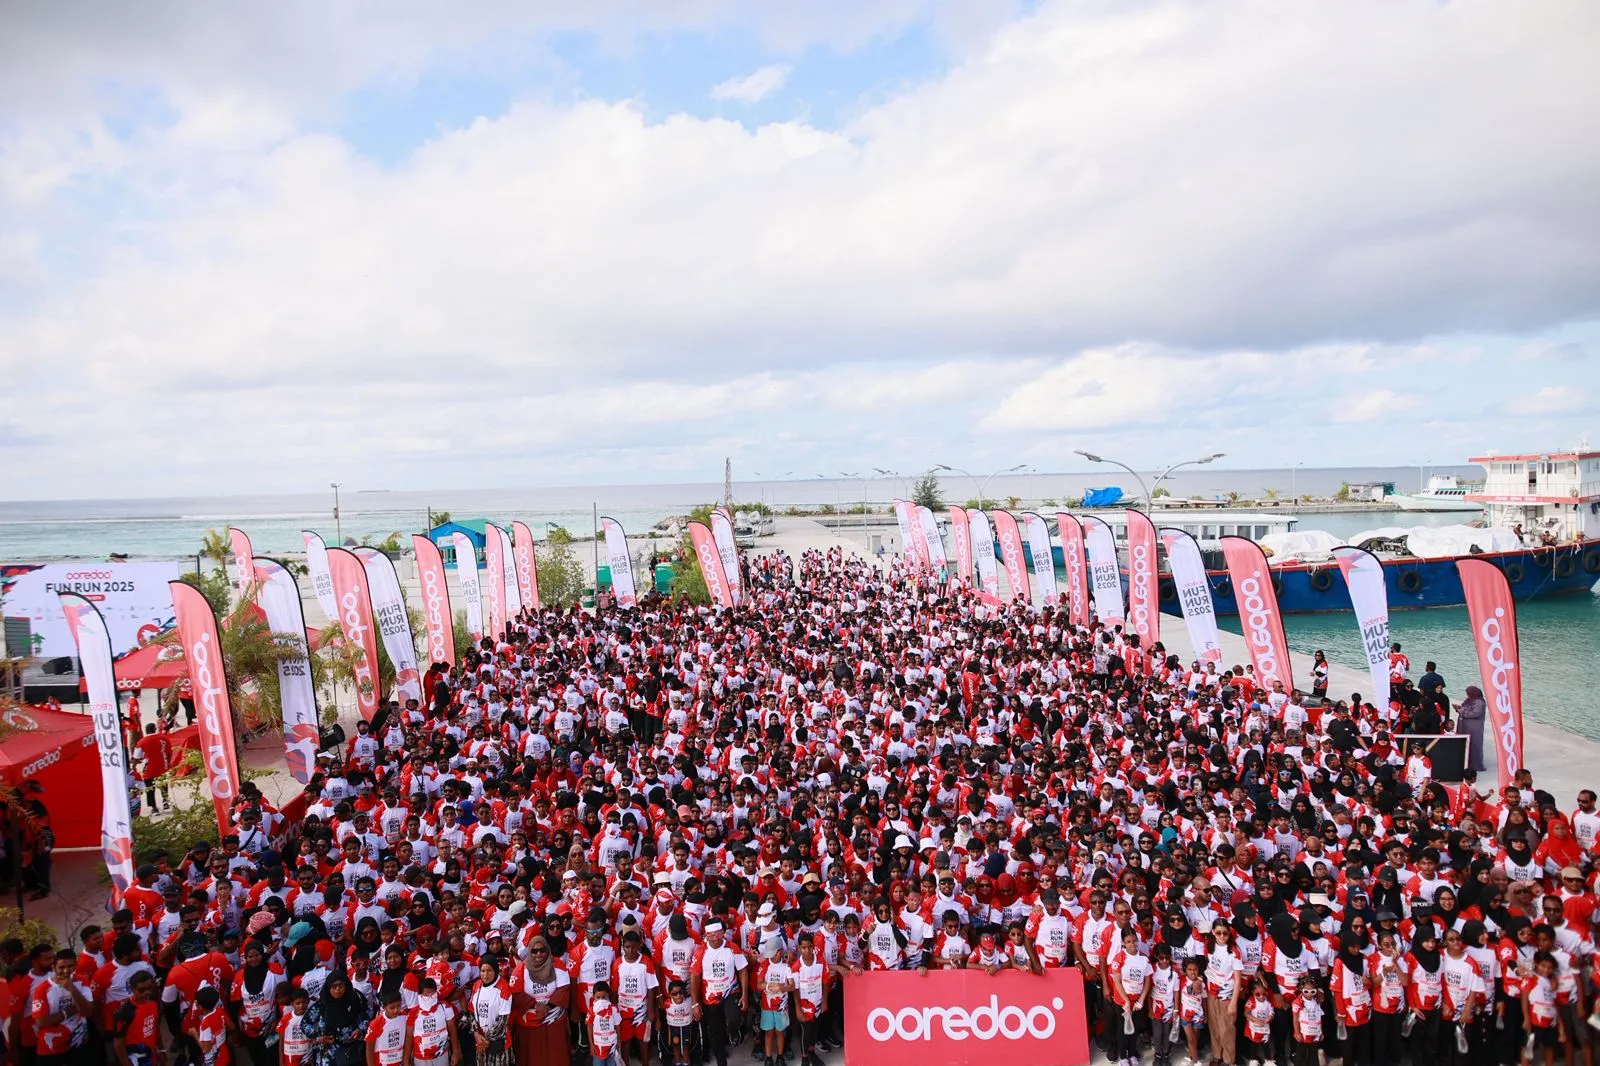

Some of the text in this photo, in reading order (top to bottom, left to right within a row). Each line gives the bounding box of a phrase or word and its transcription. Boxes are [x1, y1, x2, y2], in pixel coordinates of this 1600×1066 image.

[46, 581, 135, 593] FUN RUN 2025
[66, 569, 112, 580] ooredoo
[424, 566, 446, 660] ooredoo
[1134, 541, 1152, 635] ooredoo
[1241, 570, 1278, 690] ooredoo
[191, 633, 233, 798] ooredoo
[1481, 607, 1518, 777] ooredoo
[22, 747, 62, 777] ooredoo
[866, 994, 1064, 1041] ooredoo
